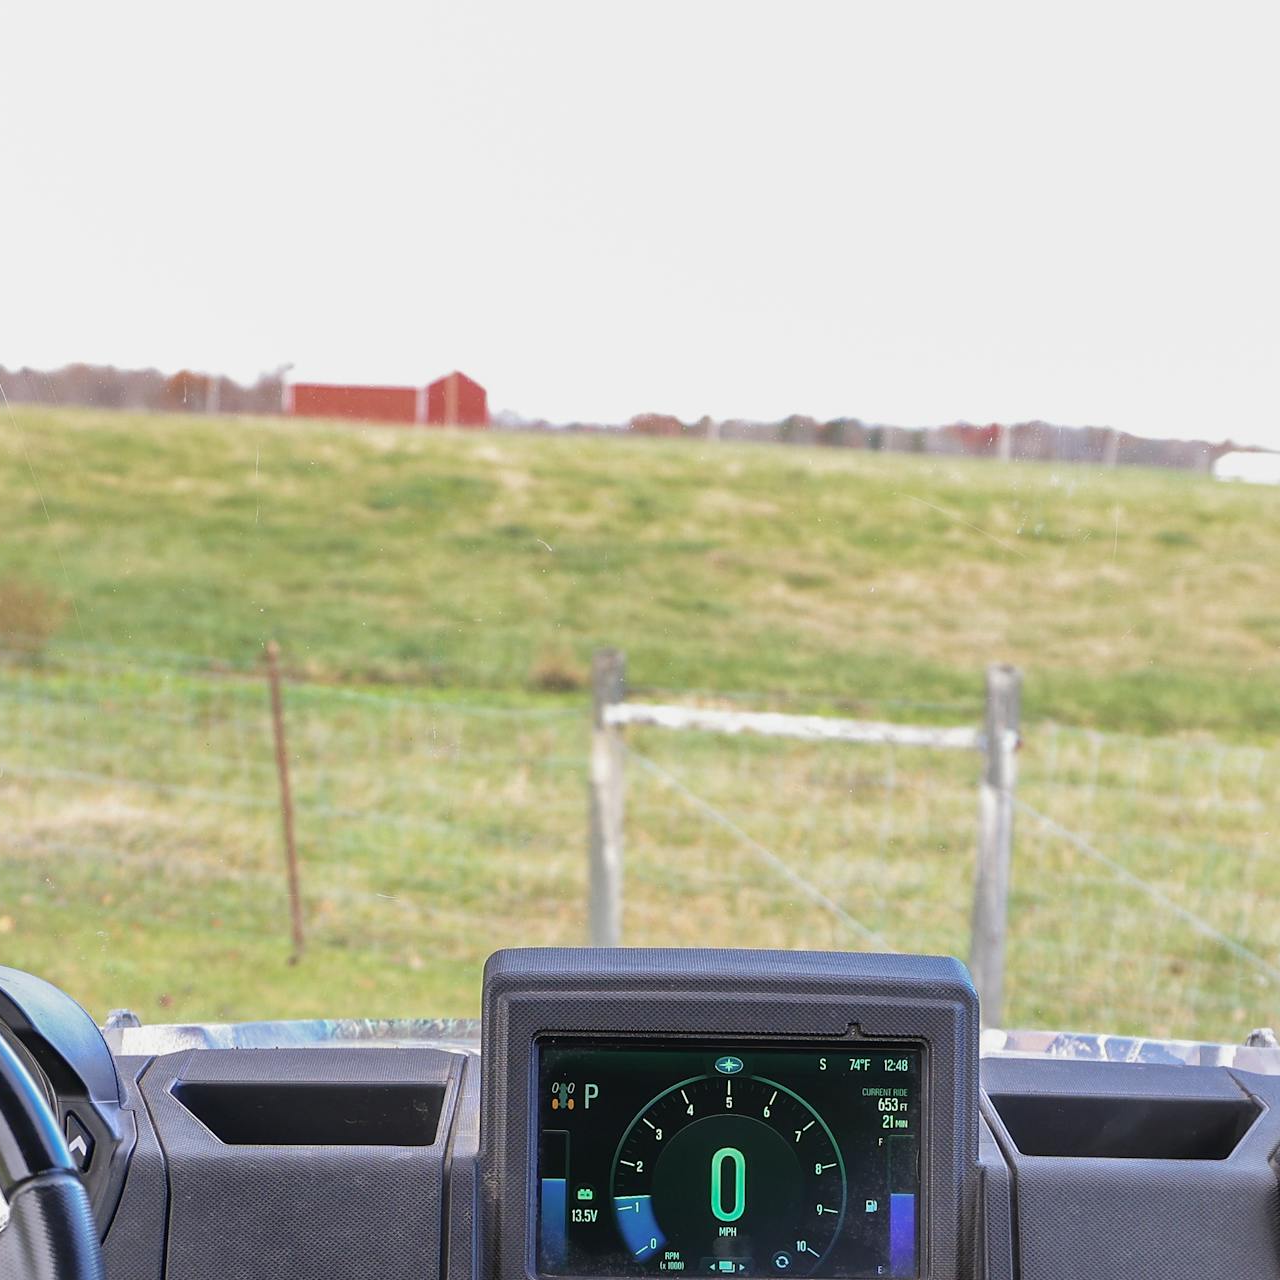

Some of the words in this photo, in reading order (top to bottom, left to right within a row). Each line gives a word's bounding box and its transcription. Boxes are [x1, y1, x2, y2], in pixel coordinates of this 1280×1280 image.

[819, 1059, 827, 1071] S
[849, 1059, 871, 1071] 74°F
[883, 1059, 909, 1072] 12:48
[584, 1083, 599, 1109] P
[862, 1087, 892, 1097] CURRENT
[893, 1087, 908, 1097] RIDE
[725, 1097, 733, 1109] 5
[877, 1098, 899, 1112] 653
[900, 1103, 908, 1111] FT
[686, 1104, 694, 1116] 4
[763, 1106, 771, 1118] 6
[882, 1116, 894, 1128] 21
[895, 1119, 908, 1128] MIN
[655, 1129, 663, 1141] 3
[794, 1131, 802, 1143] 7
[878, 1137, 884, 1147] F
[636, 1161, 644, 1173] 2
[815, 1163, 822, 1175] 8
[711, 1147, 746, 1222] 0
[634, 1202, 640, 1213] 1
[816, 1204, 824, 1215] 9
[571, 1209, 598, 1223] 13.5V
[719, 1226, 737, 1237] MPH
[650, 1238, 657, 1250] 0
[796, 1240, 807, 1252] 10
[664, 1251, 680, 1260] RPM
[659, 1260, 668, 1272] (x
[668, 1260, 685, 1272] 1000)
[877, 1265, 883, 1274] E
